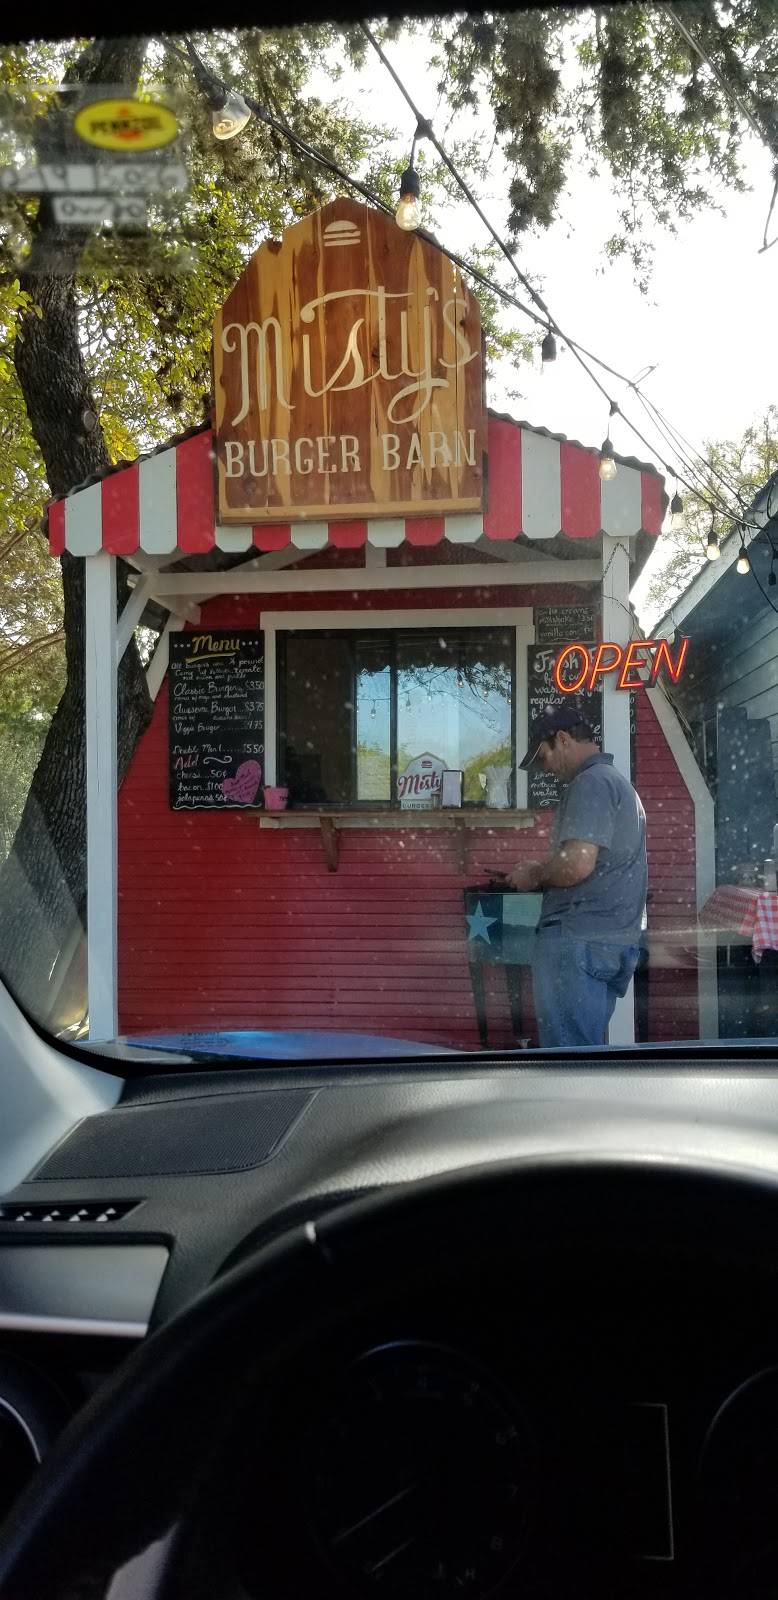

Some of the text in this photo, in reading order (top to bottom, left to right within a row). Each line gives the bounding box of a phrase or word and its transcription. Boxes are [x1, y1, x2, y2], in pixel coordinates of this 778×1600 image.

[220, 286, 478, 426] Misty's
[224, 429, 477, 478] BURGER BARN
[192, 635, 240, 653] Menu
[554, 639, 689, 692] OPEN
